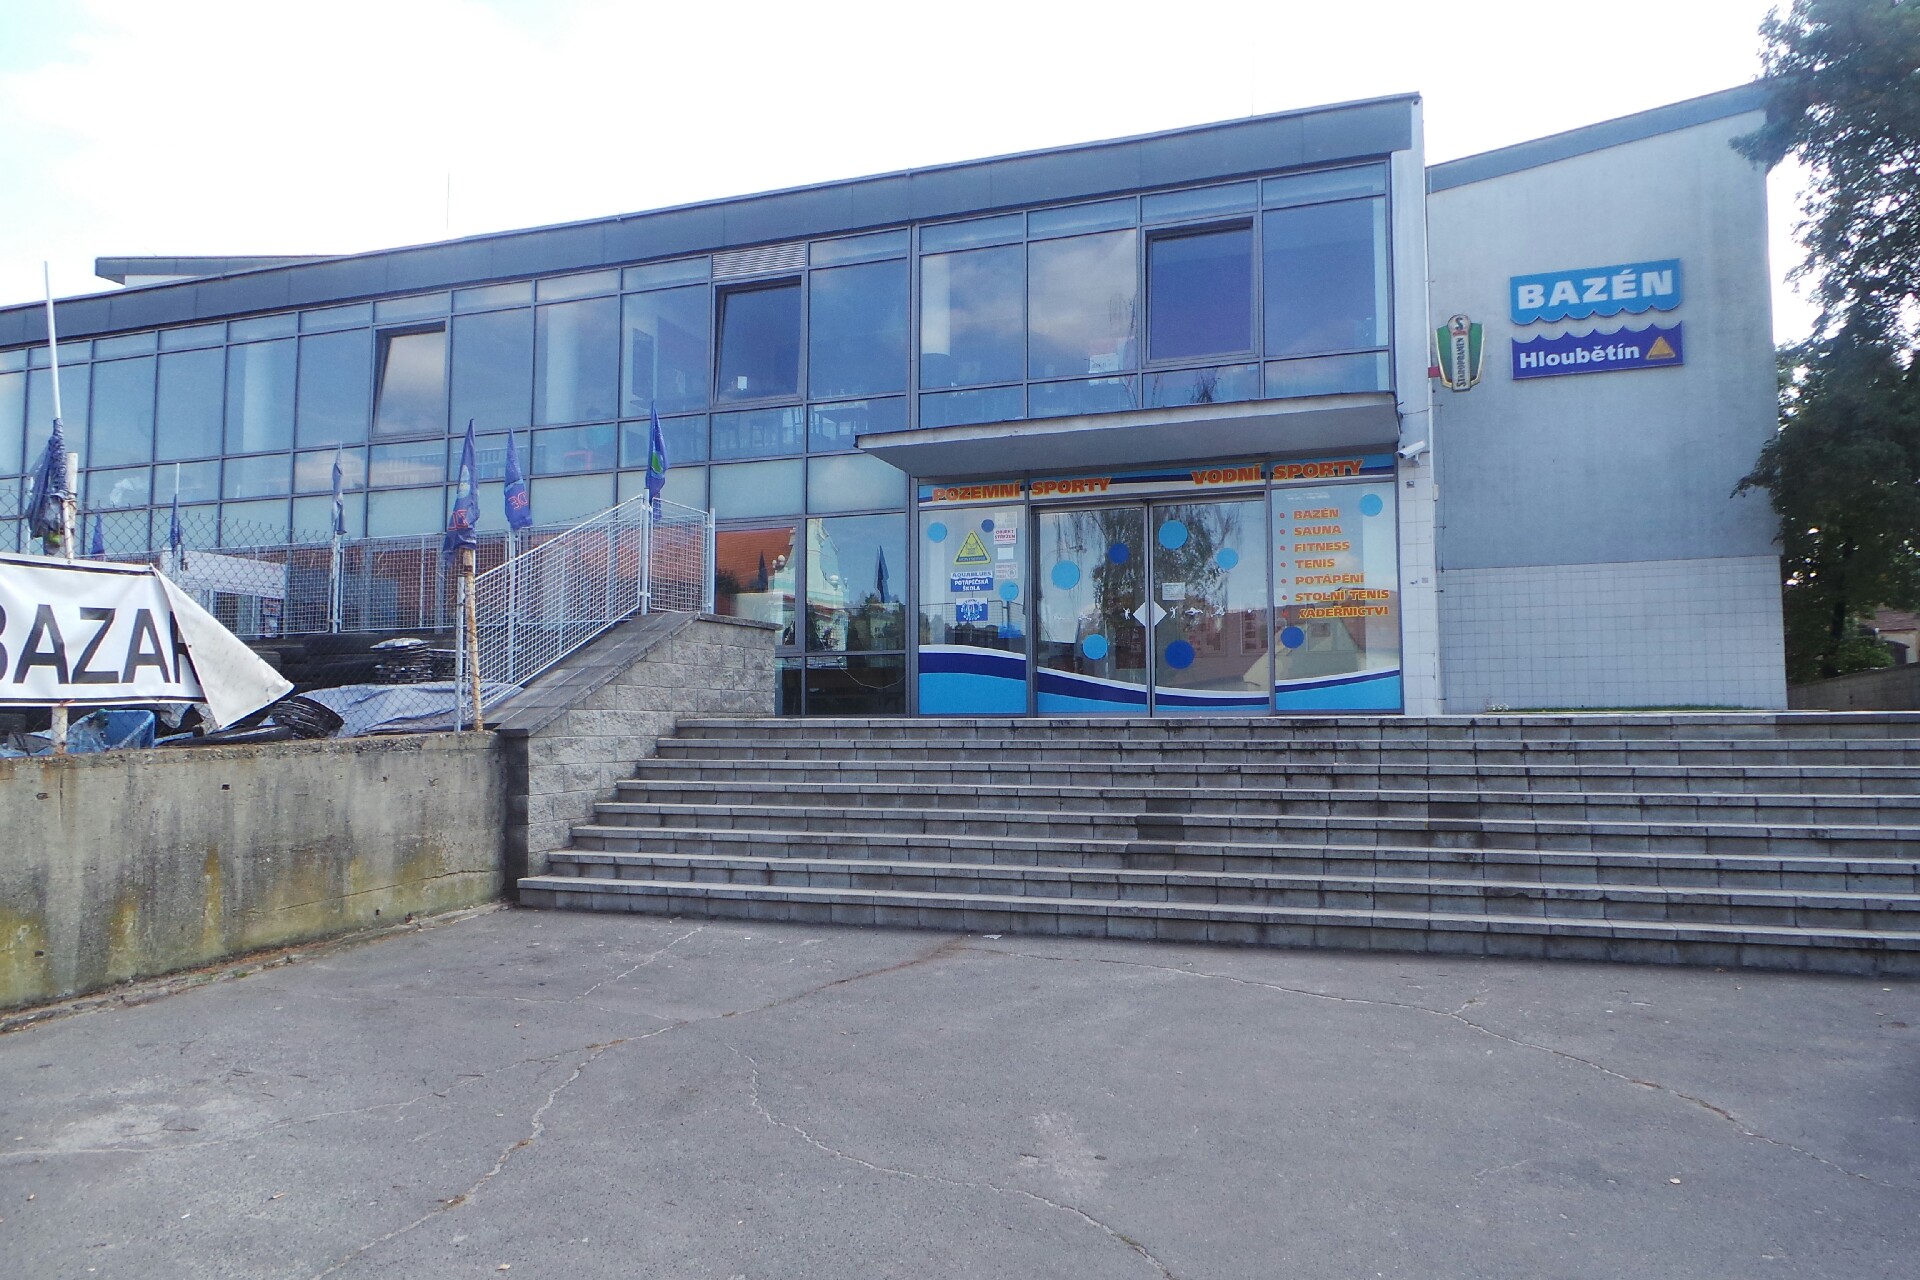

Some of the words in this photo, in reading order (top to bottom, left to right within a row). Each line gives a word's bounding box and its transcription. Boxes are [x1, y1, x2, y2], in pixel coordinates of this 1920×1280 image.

[1517, 269, 1673, 310] BAZÉN
[1519, 343, 1640, 369] Hloubětín
[1191, 463, 1262, 485] VODNÍ
[1272, 459, 1364, 480] SPORTY
[932, 480, 1021, 502] POZEMNÍ
[1031, 477, 1112, 496] SPORTY
[1293, 508, 1340, 520] BAZÉN
[1294, 525, 1343, 536] SAUNA
[1294, 541, 1350, 553] FITNESS
[1294, 558, 1336, 569] TENIS
[1295, 589, 1346, 602] STOLNÍ
[1349, 589, 1390, 600] TENIS
[0, 603, 201, 685] AZAR
